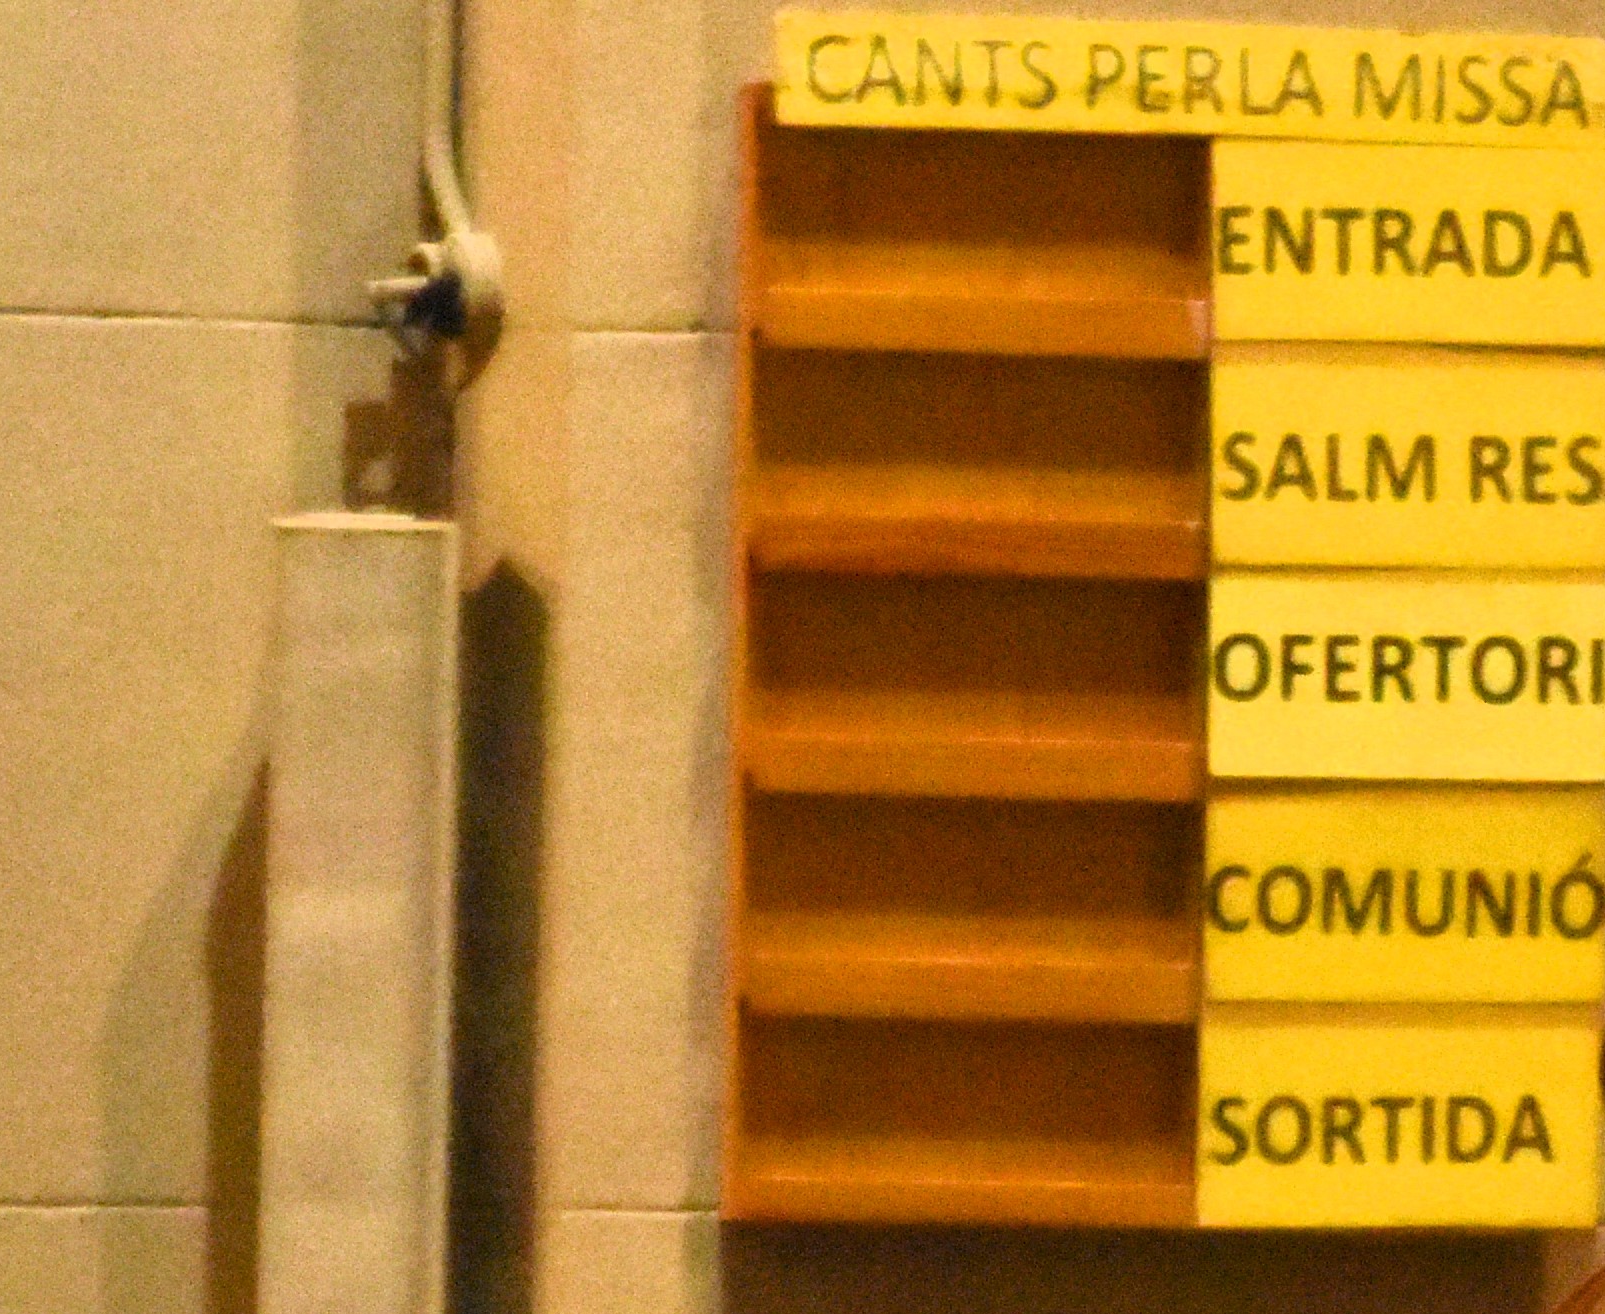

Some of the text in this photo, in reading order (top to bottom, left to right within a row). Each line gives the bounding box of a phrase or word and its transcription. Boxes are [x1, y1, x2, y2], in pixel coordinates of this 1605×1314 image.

[807, 35, 1057, 110] CANTS
[1352, 52, 1590, 129] MISSA
[1218, 206, 1591, 279] ENTRADA
[1221, 430, 1605, 506] SALM RES
[1213, 633, 1605, 705] OFERTORI
[1210, 1094, 1554, 1167] SORTIDA
